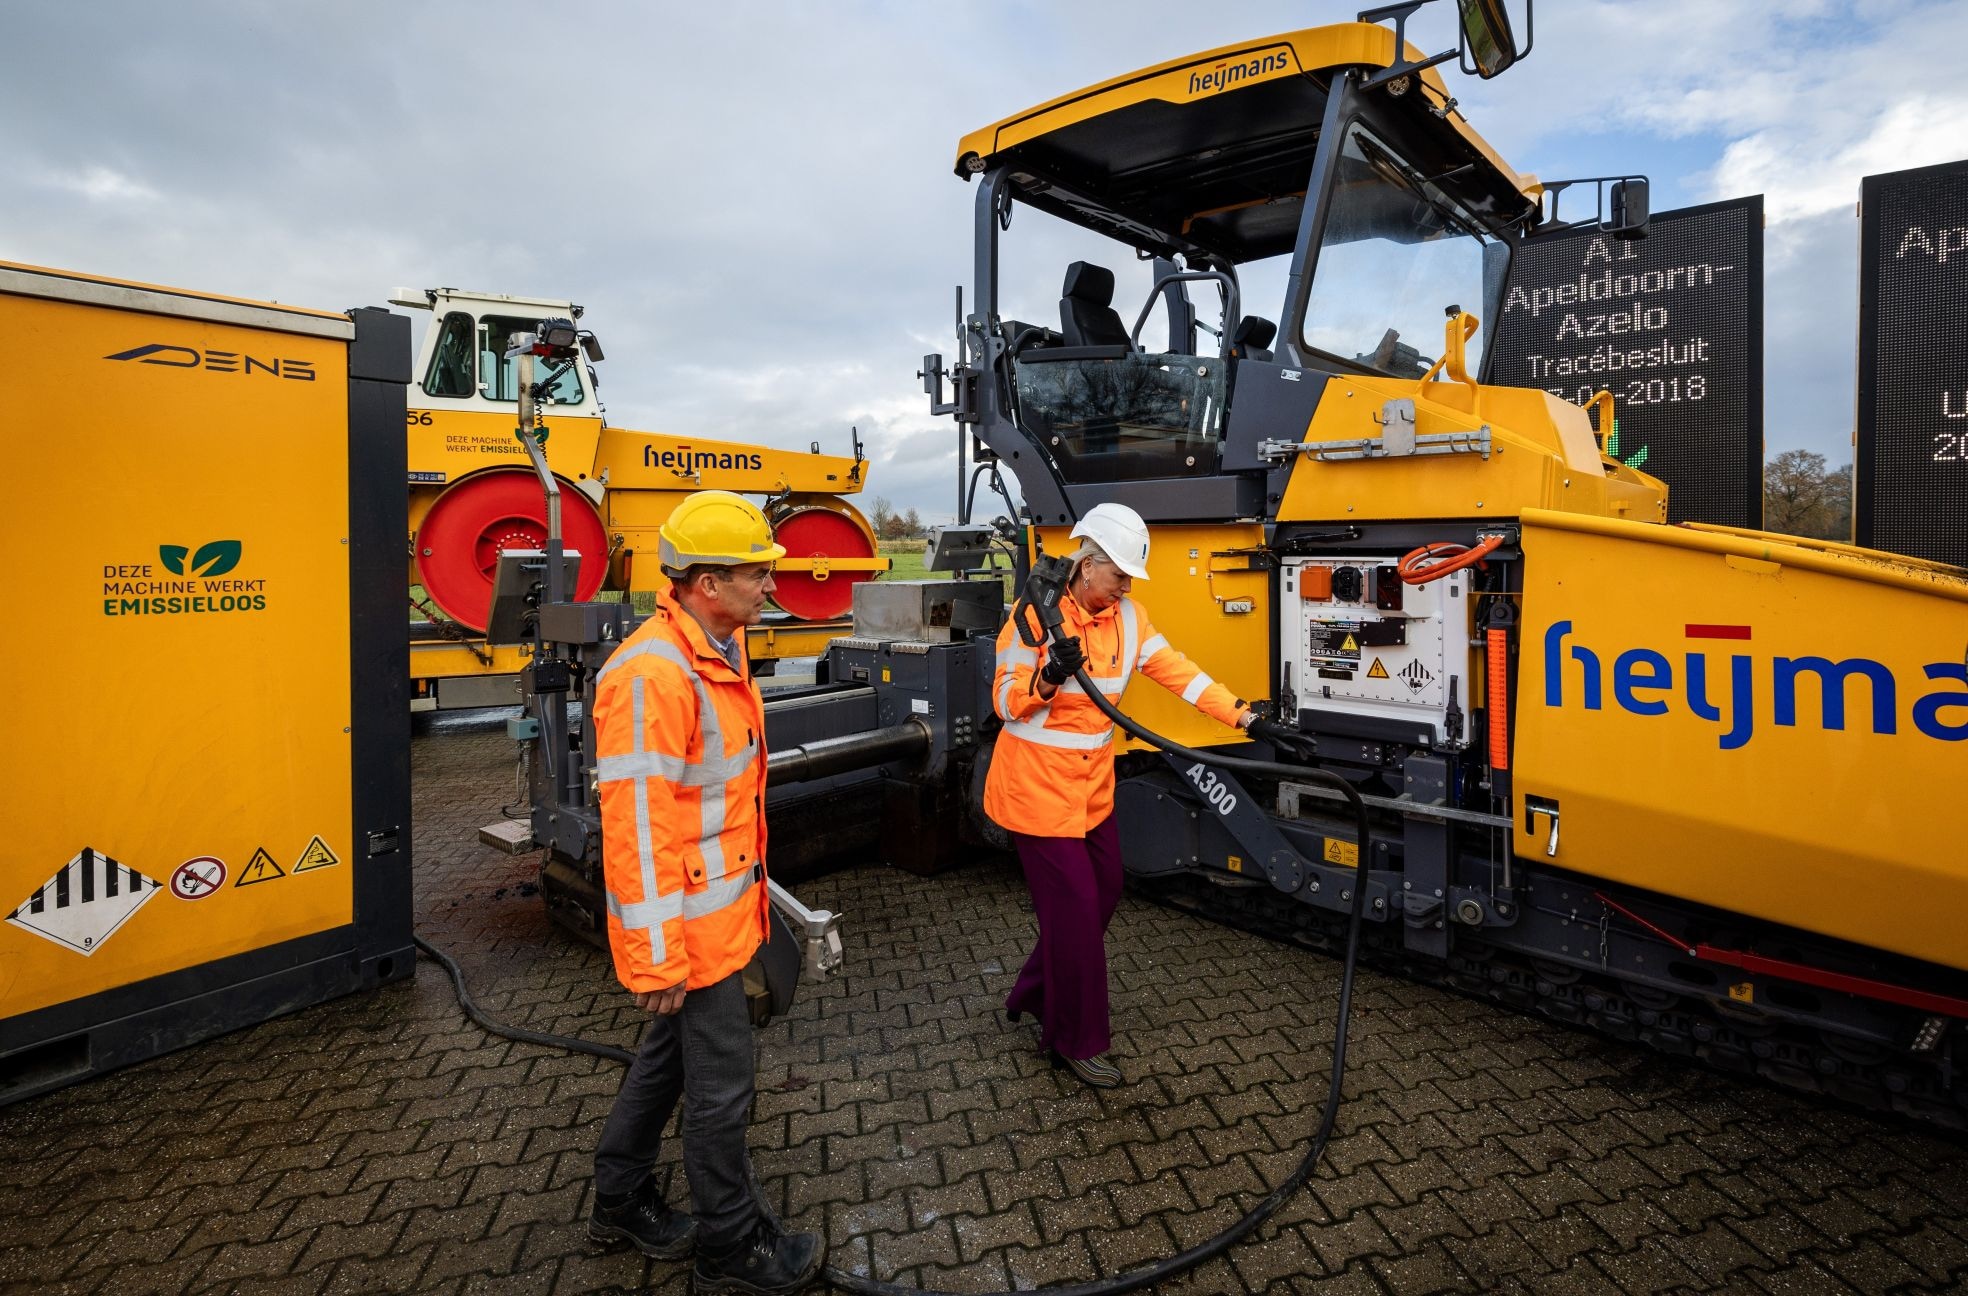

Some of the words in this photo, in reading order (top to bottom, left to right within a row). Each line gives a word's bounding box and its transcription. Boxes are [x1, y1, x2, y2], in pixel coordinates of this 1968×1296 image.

[1504, 263, 1734, 317] Apeldoorn-
[1556, 302, 1668, 341] Azelo
[1527, 337, 1710, 379] Tracébesluit
[407, 411, 433, 426] 56
[446, 435, 469, 444] DEZE
[471, 436, 513, 445] MACHINE
[446, 445, 478, 453] WERKT
[103, 565, 153, 578] DEZE
[103, 580, 196, 595] MACHINE
[204, 579, 266, 593] WERKT
[103, 594, 267, 616] EMISSIELOOS
[1185, 763, 1237, 816] A300
[84, 937, 93, 948] 9
